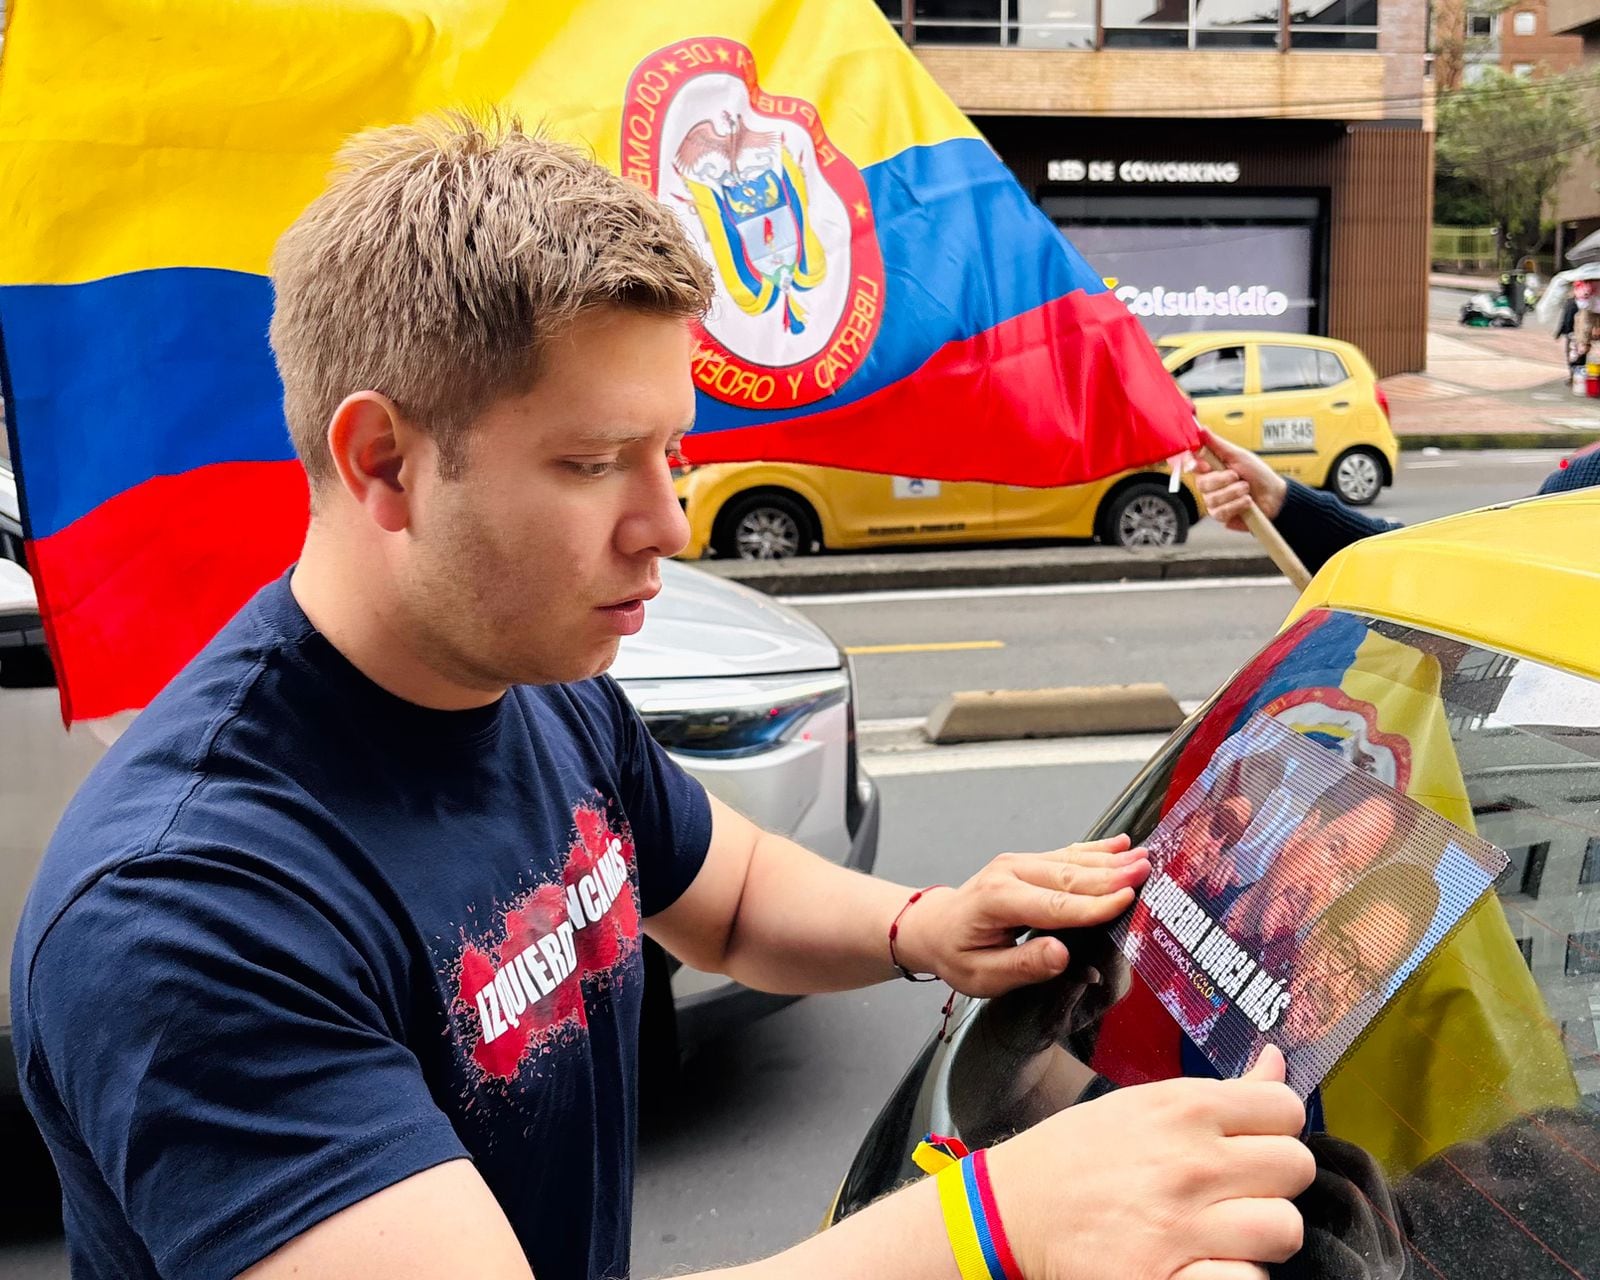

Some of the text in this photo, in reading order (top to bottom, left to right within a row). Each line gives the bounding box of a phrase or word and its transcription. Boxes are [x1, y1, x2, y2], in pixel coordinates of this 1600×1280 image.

[1048, 160, 1241, 183] RED DE COWORKING
[1114, 285, 1289, 316] Colsubsidio
[475, 920, 578, 1045] IZQUIERD
[1192, 925, 1257, 999] NUNCA
[1235, 969, 1292, 1032] MÁS
